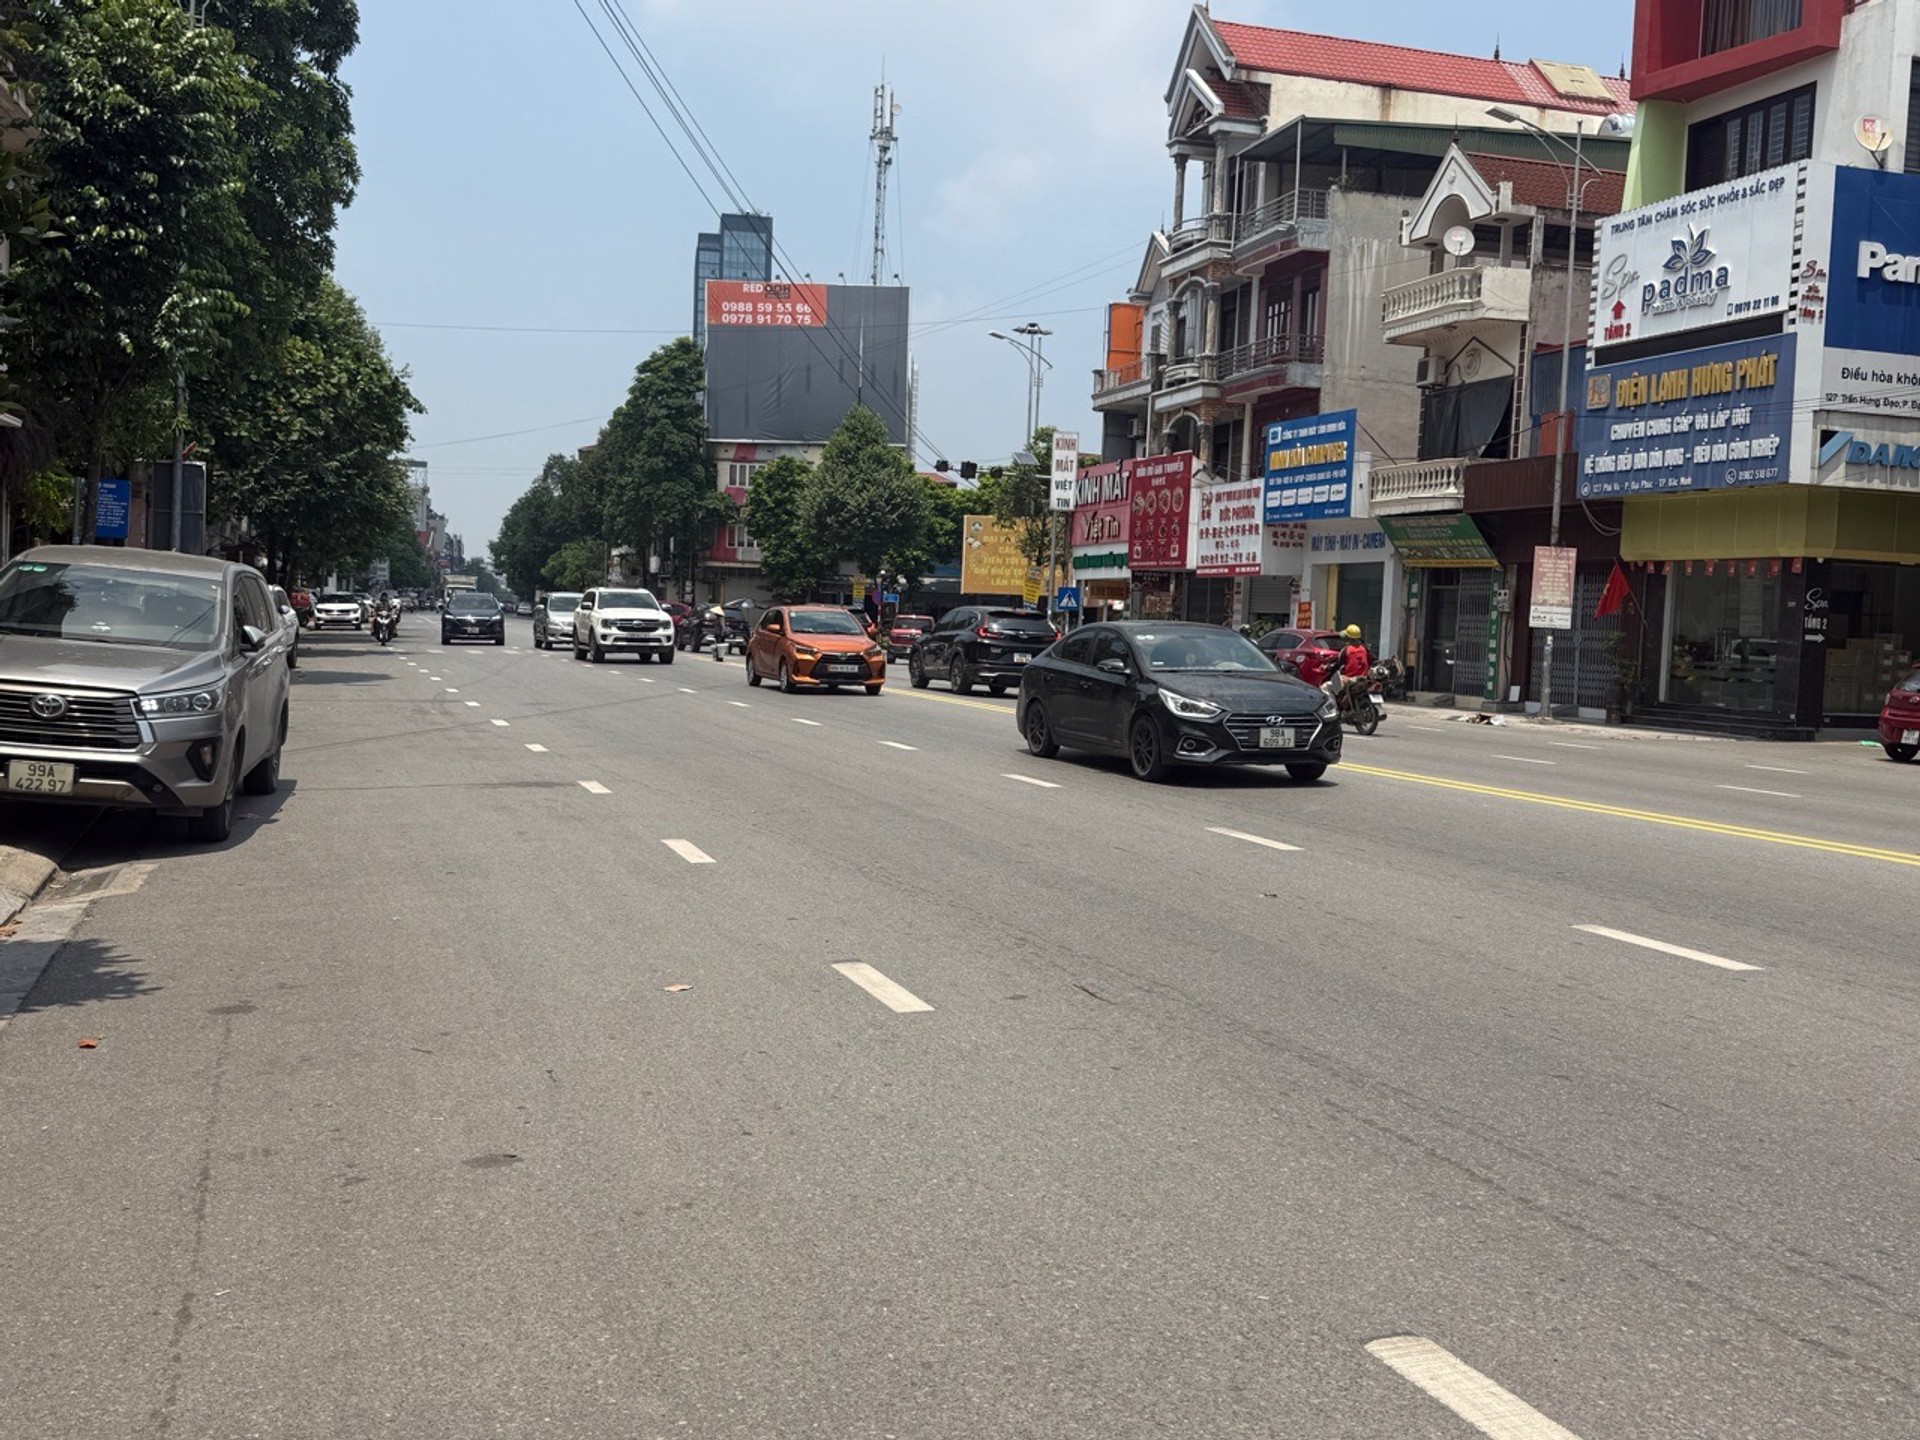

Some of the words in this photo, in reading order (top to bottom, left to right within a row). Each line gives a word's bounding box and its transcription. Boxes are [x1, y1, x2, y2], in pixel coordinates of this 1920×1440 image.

[1611, 219, 1634, 234] TRUNG
[1638, 215, 1652, 228] TÂM
[1656, 207, 1678, 222] CHĂM
[1680, 202, 1696, 216] SÓC
[1700, 196, 1716, 210] SỨC
[1718, 186, 1739, 204] KHỎE
[1741, 190, 1748, 199] &
[1750, 178, 1765, 196] SẮC
[1769, 177, 1785, 193] ĐẸP
[1601, 253, 1640, 300] Spa
[742, 284, 763, 292] RED
[1642, 266, 1730, 312] padma
[722, 302, 752, 312] 0988
[757, 302, 772, 312] 59
[777, 303, 792, 312] 55
[796, 303, 812, 313] 66
[722, 313, 752, 323] 0978
[757, 314, 771, 324] 91
[776, 314, 792, 324] 70
[796, 314, 811, 324] 75
[1626, 323, 1632, 336] 2
[1616, 371, 1648, 412] ĐIỆN
[1652, 368, 1688, 408] LẠNH
[1692, 362, 1732, 398] HƯNG
[1736, 350, 1778, 390] PHÁT
[1872, 370, 1893, 384] hòa
[1825, 393, 1838, 402] 127
[1056, 435, 1076, 450] KÍNH
[1055, 479, 1073, 492] VIỆT
[1074, 471, 1102, 506] KÍNH
[1104, 459, 1130, 501] MẮT
[1056, 498, 1070, 508] TIN
[1823, 618, 1827, 630] 2
[28, 764, 55, 777] 99A
[15, 778, 66, 792] 422.97
